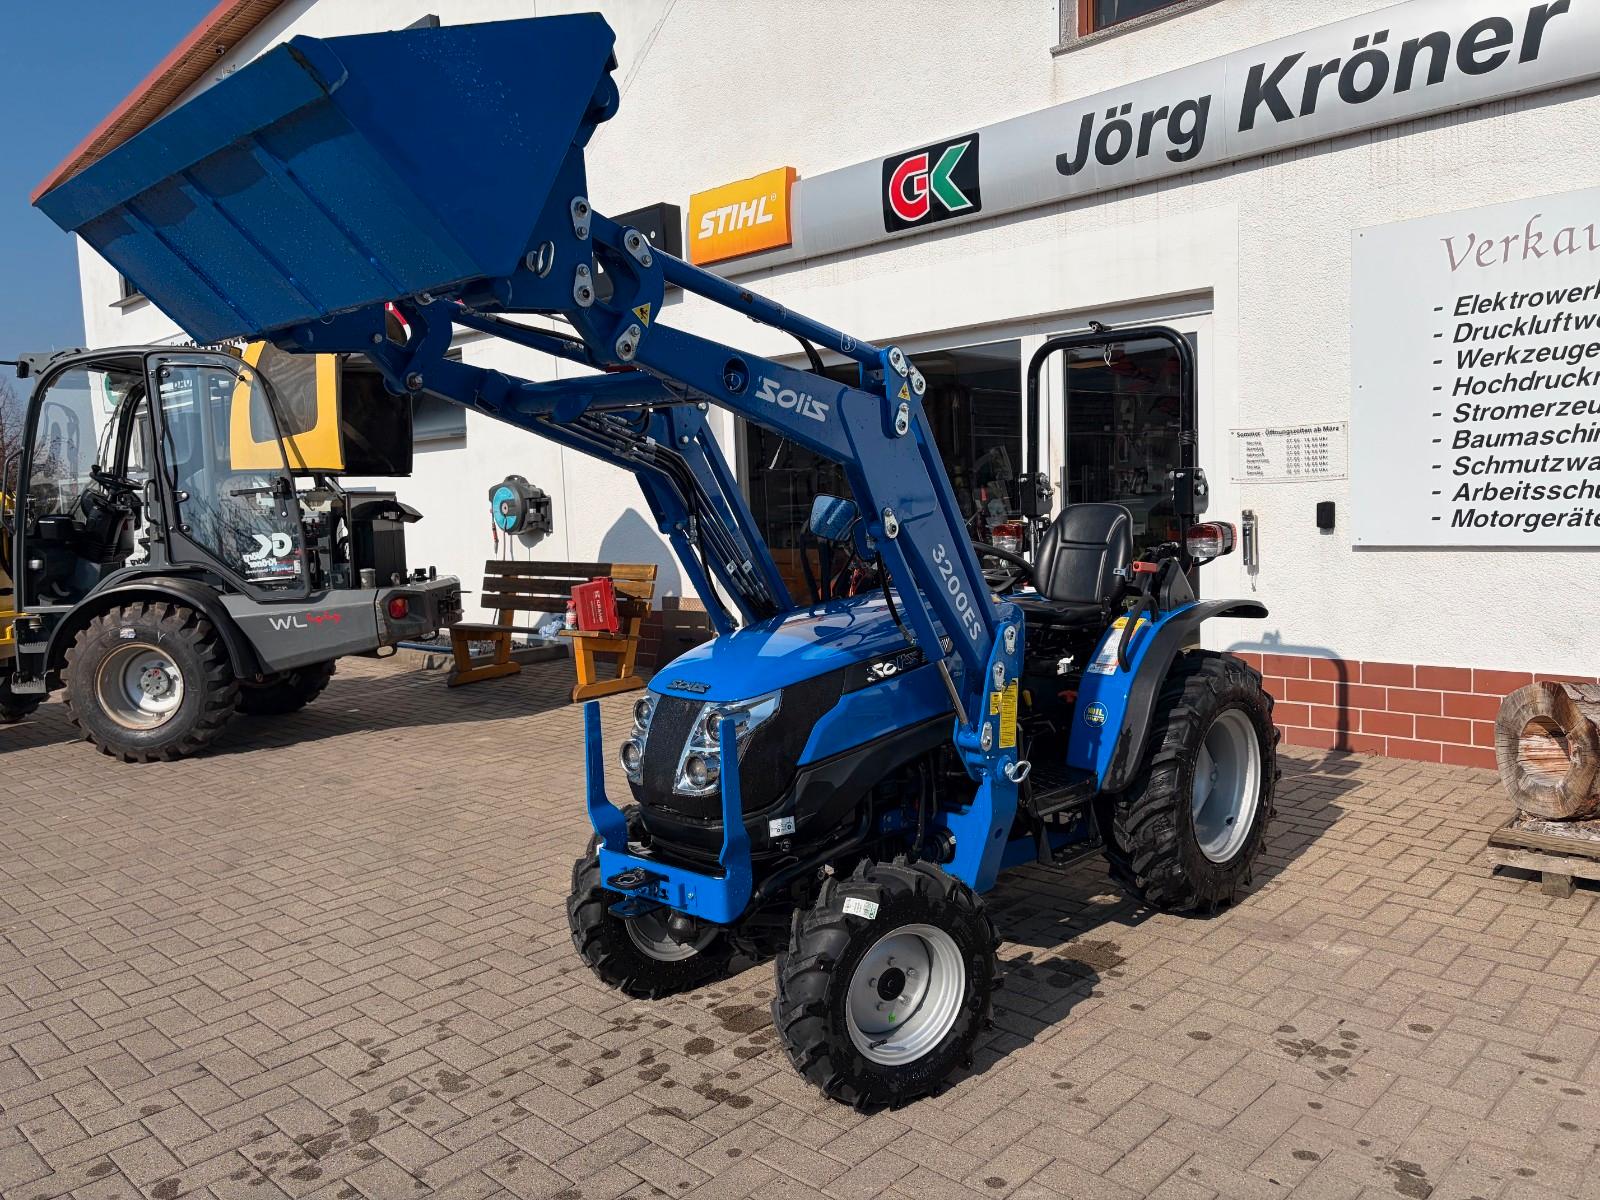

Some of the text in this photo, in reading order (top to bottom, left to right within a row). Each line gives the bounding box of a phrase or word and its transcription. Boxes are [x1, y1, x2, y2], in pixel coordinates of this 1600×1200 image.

[1056, 0, 1571, 176] Jörg Kröner
[268, 615, 308, 630] WL
[932, 543, 982, 641] 3200ES
